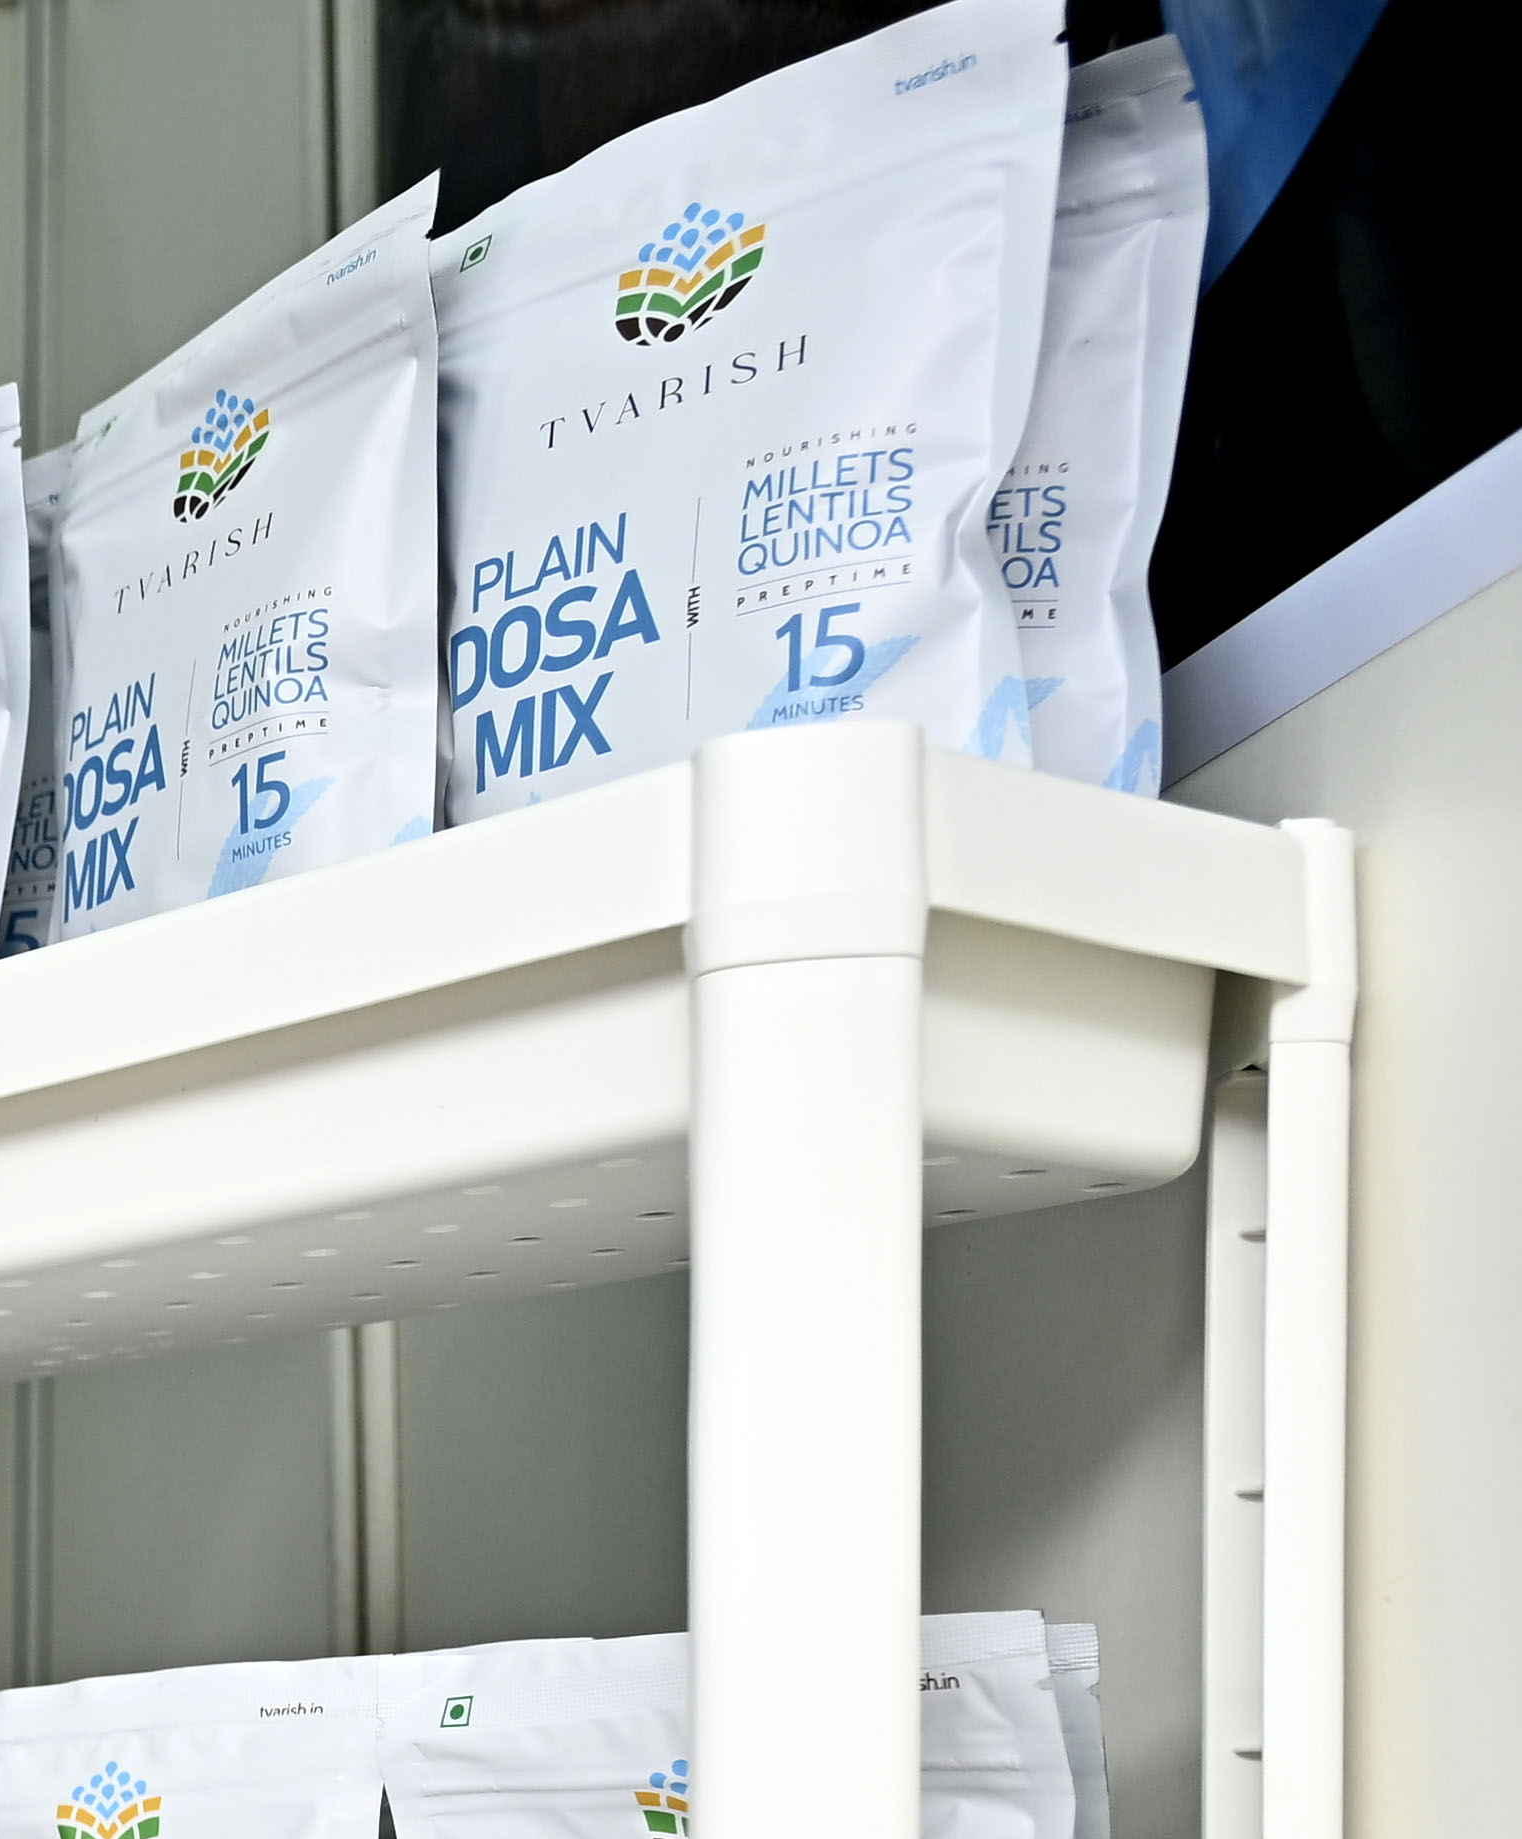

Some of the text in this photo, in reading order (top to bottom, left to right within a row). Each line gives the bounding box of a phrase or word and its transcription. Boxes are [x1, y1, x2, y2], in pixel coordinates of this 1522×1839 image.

[539, 335, 807, 449] TVARISH
[746, 423, 918, 468] NOURISHING
[742, 449, 914, 510] MILLETS
[742, 485, 912, 543] LENTILS
[114, 512, 274, 614] TVARISH
[473, 512, 627, 613] PLAIN
[737, 517, 911, 576] QUINOA
[223, 586, 333, 632] NOURISHING
[687, 586, 700, 628] WITH
[737, 565, 911, 608] PREPTIME
[218, 609, 328, 670] MILLETS
[450, 569, 660, 714] DOSA
[775, 603, 866, 693] 15
[213, 641, 328, 701] LENTILS
[70, 672, 155, 761] PLAIN
[212, 676, 327, 729] QUINOA
[772, 695, 864, 723] MINUTES
[208, 718, 328, 759] PREPTIME
[476, 672, 614, 795] MIX
[231, 750, 291, 834] 15
[64, 817, 139, 923] MIX
[232, 832, 291, 862] MINUTES
